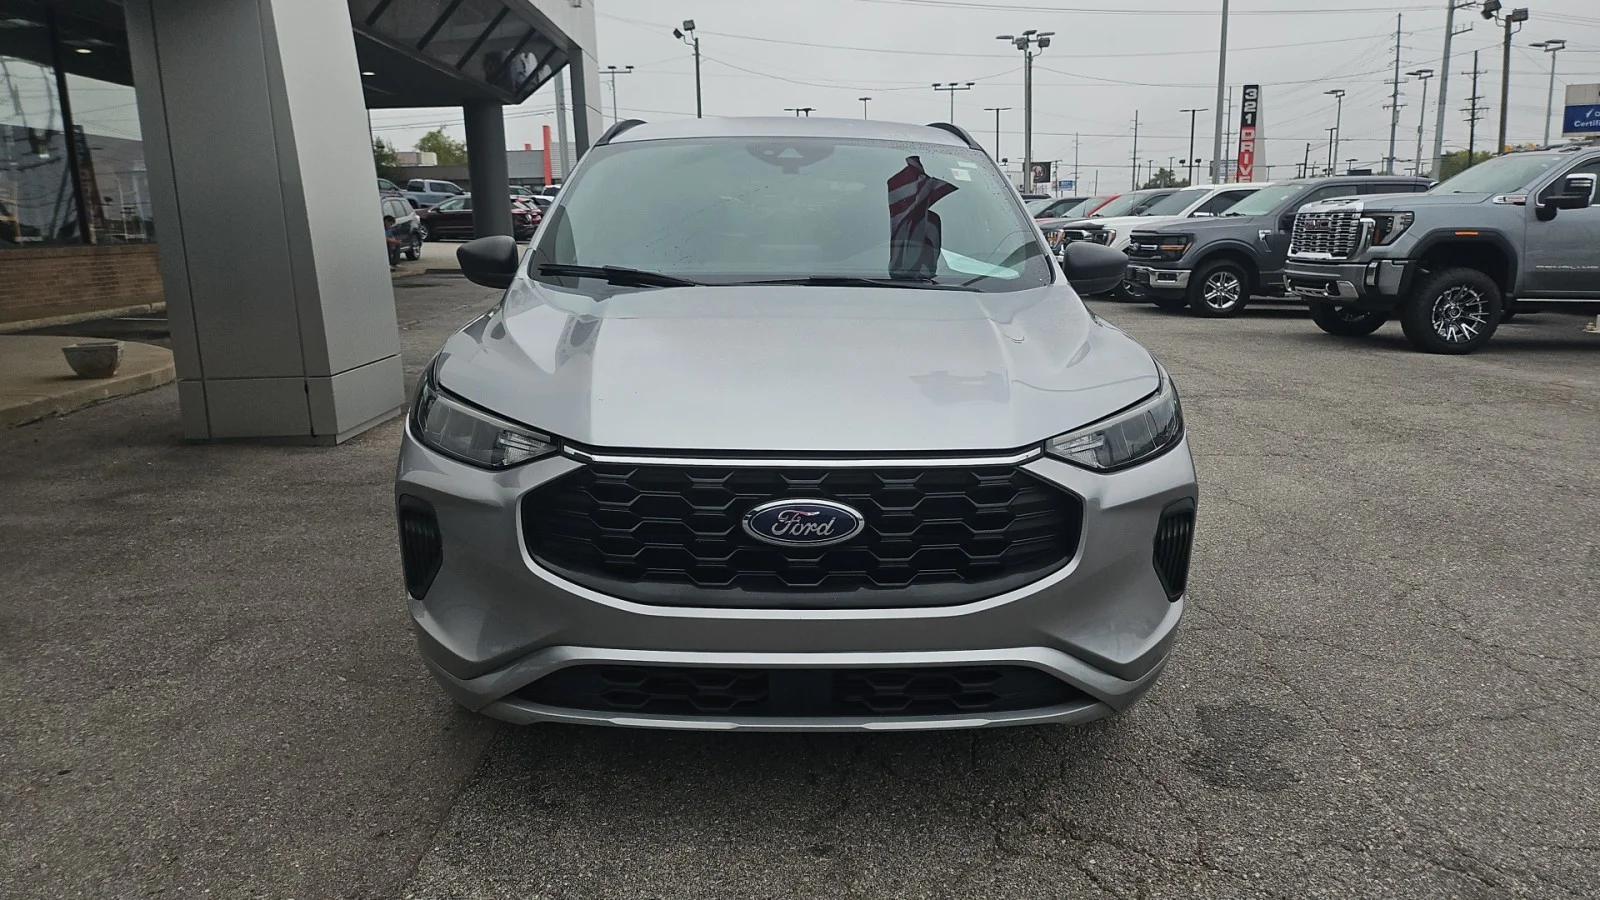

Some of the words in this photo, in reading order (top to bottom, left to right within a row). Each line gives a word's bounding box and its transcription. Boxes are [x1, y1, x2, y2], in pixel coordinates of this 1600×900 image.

[1244, 88, 1257, 124] 321
[1238, 129, 1255, 183] DRIVE
[771, 509, 836, 536] Ford
